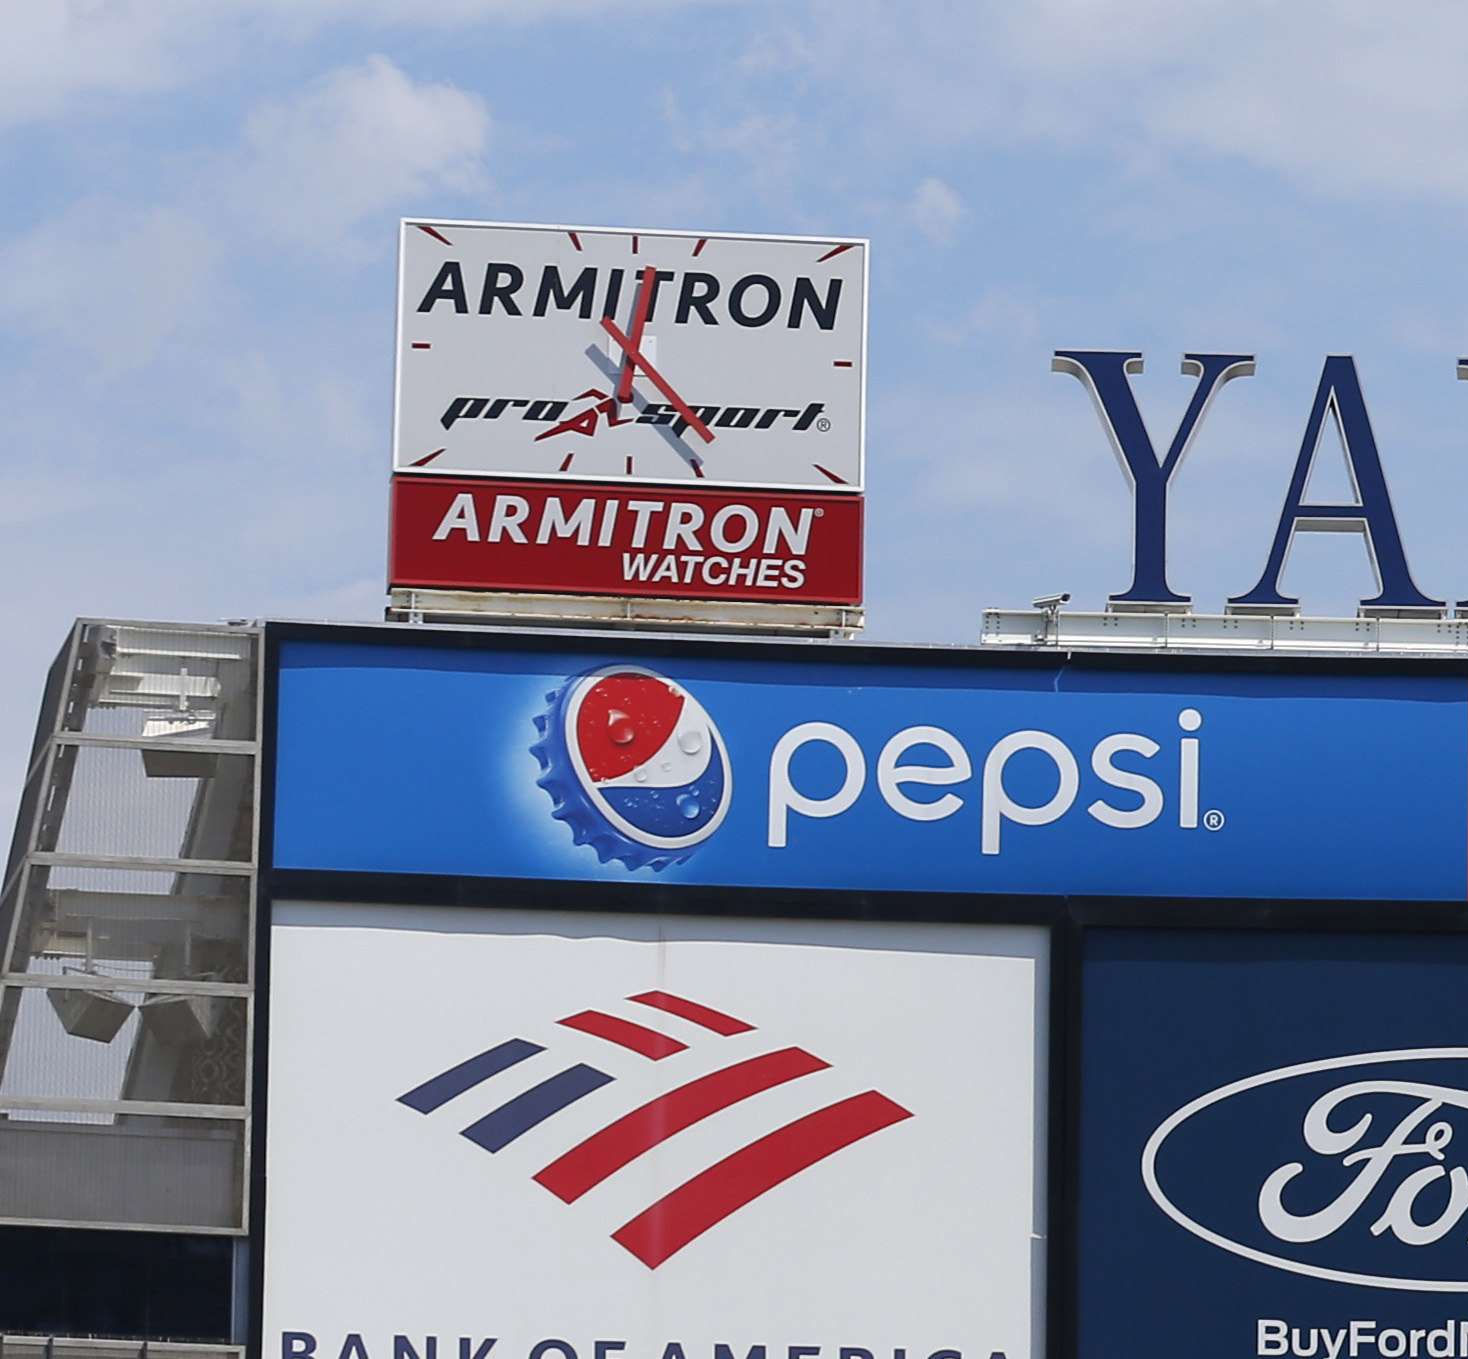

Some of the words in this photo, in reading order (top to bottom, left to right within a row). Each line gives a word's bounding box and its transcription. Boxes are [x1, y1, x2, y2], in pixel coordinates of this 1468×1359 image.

[416, 260, 843, 331] ARMITRON
[440, 397, 569, 431] pro
[432, 493, 815, 556] ARMITRON
[621, 552, 807, 590] WATCHES
[768, 709, 1201, 855] pepsi
